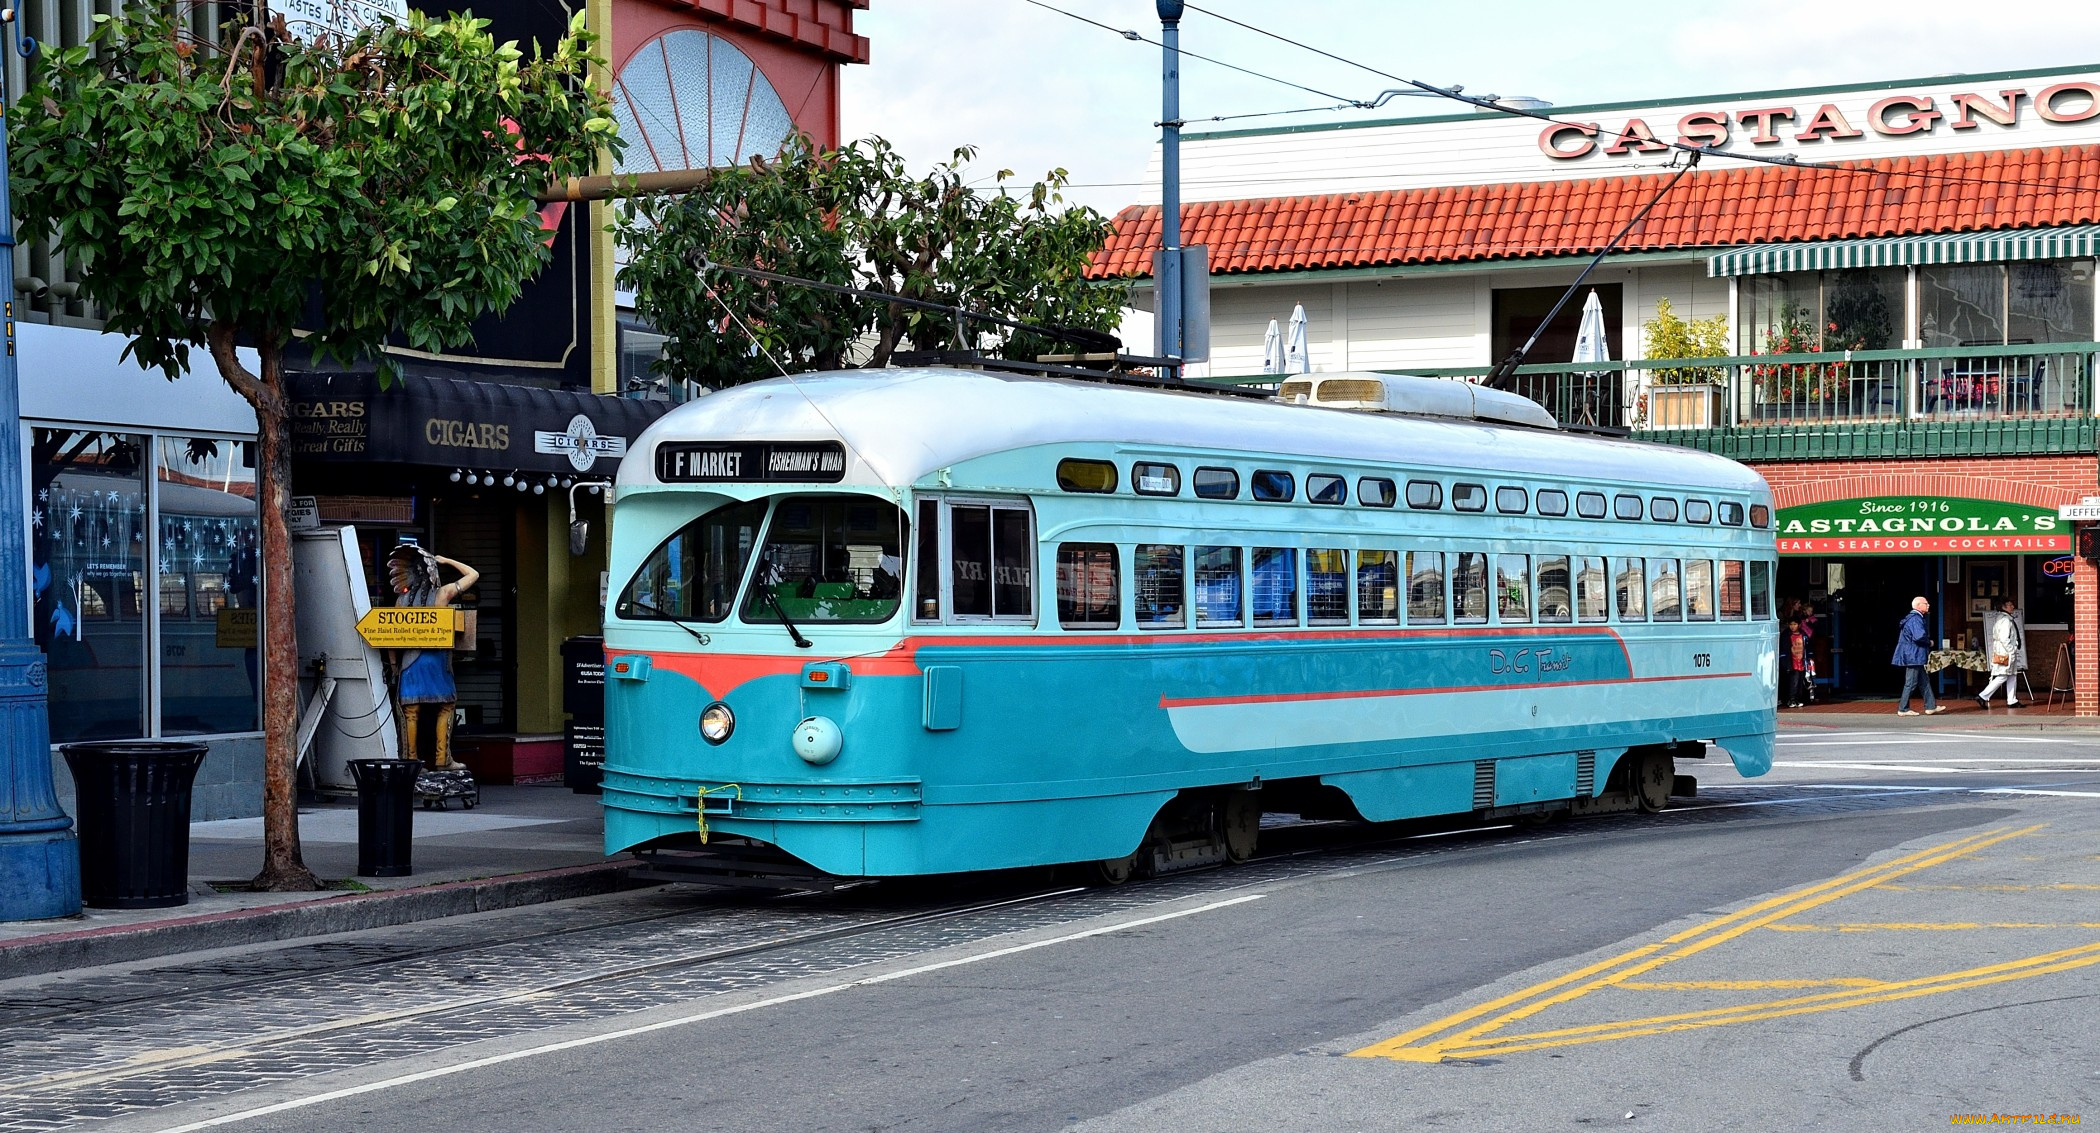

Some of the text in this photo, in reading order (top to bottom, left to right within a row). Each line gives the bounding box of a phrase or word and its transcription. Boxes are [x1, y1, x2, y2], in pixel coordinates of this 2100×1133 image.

[284, 0, 321, 19] TASTES
[1538, 81, 2100, 159] CASTAGNO
[290, 402, 365, 418] GARS
[328, 420, 366, 436] Really
[425, 418, 510, 450] CIGARS
[293, 438, 365, 453] Great Gifts
[675, 452, 742, 477] F MARKET
[768, 451, 820, 472] FISHERMAN'S
[1859, 501, 1950, 515] Since 1916
[1775, 514, 2057, 534] ASTAGNOLA'S
[1838, 539, 1923, 549] SEAFOOD
[1948, 538, 2056, 549] COCKTAILS
[378, 611, 438, 625] STOGIES
[412, 627, 429, 635] Cigars
[437, 627, 452, 635] Pipes
[1535, 649, 1572, 681] Transit
[1693, 653, 1711, 668] 1076
